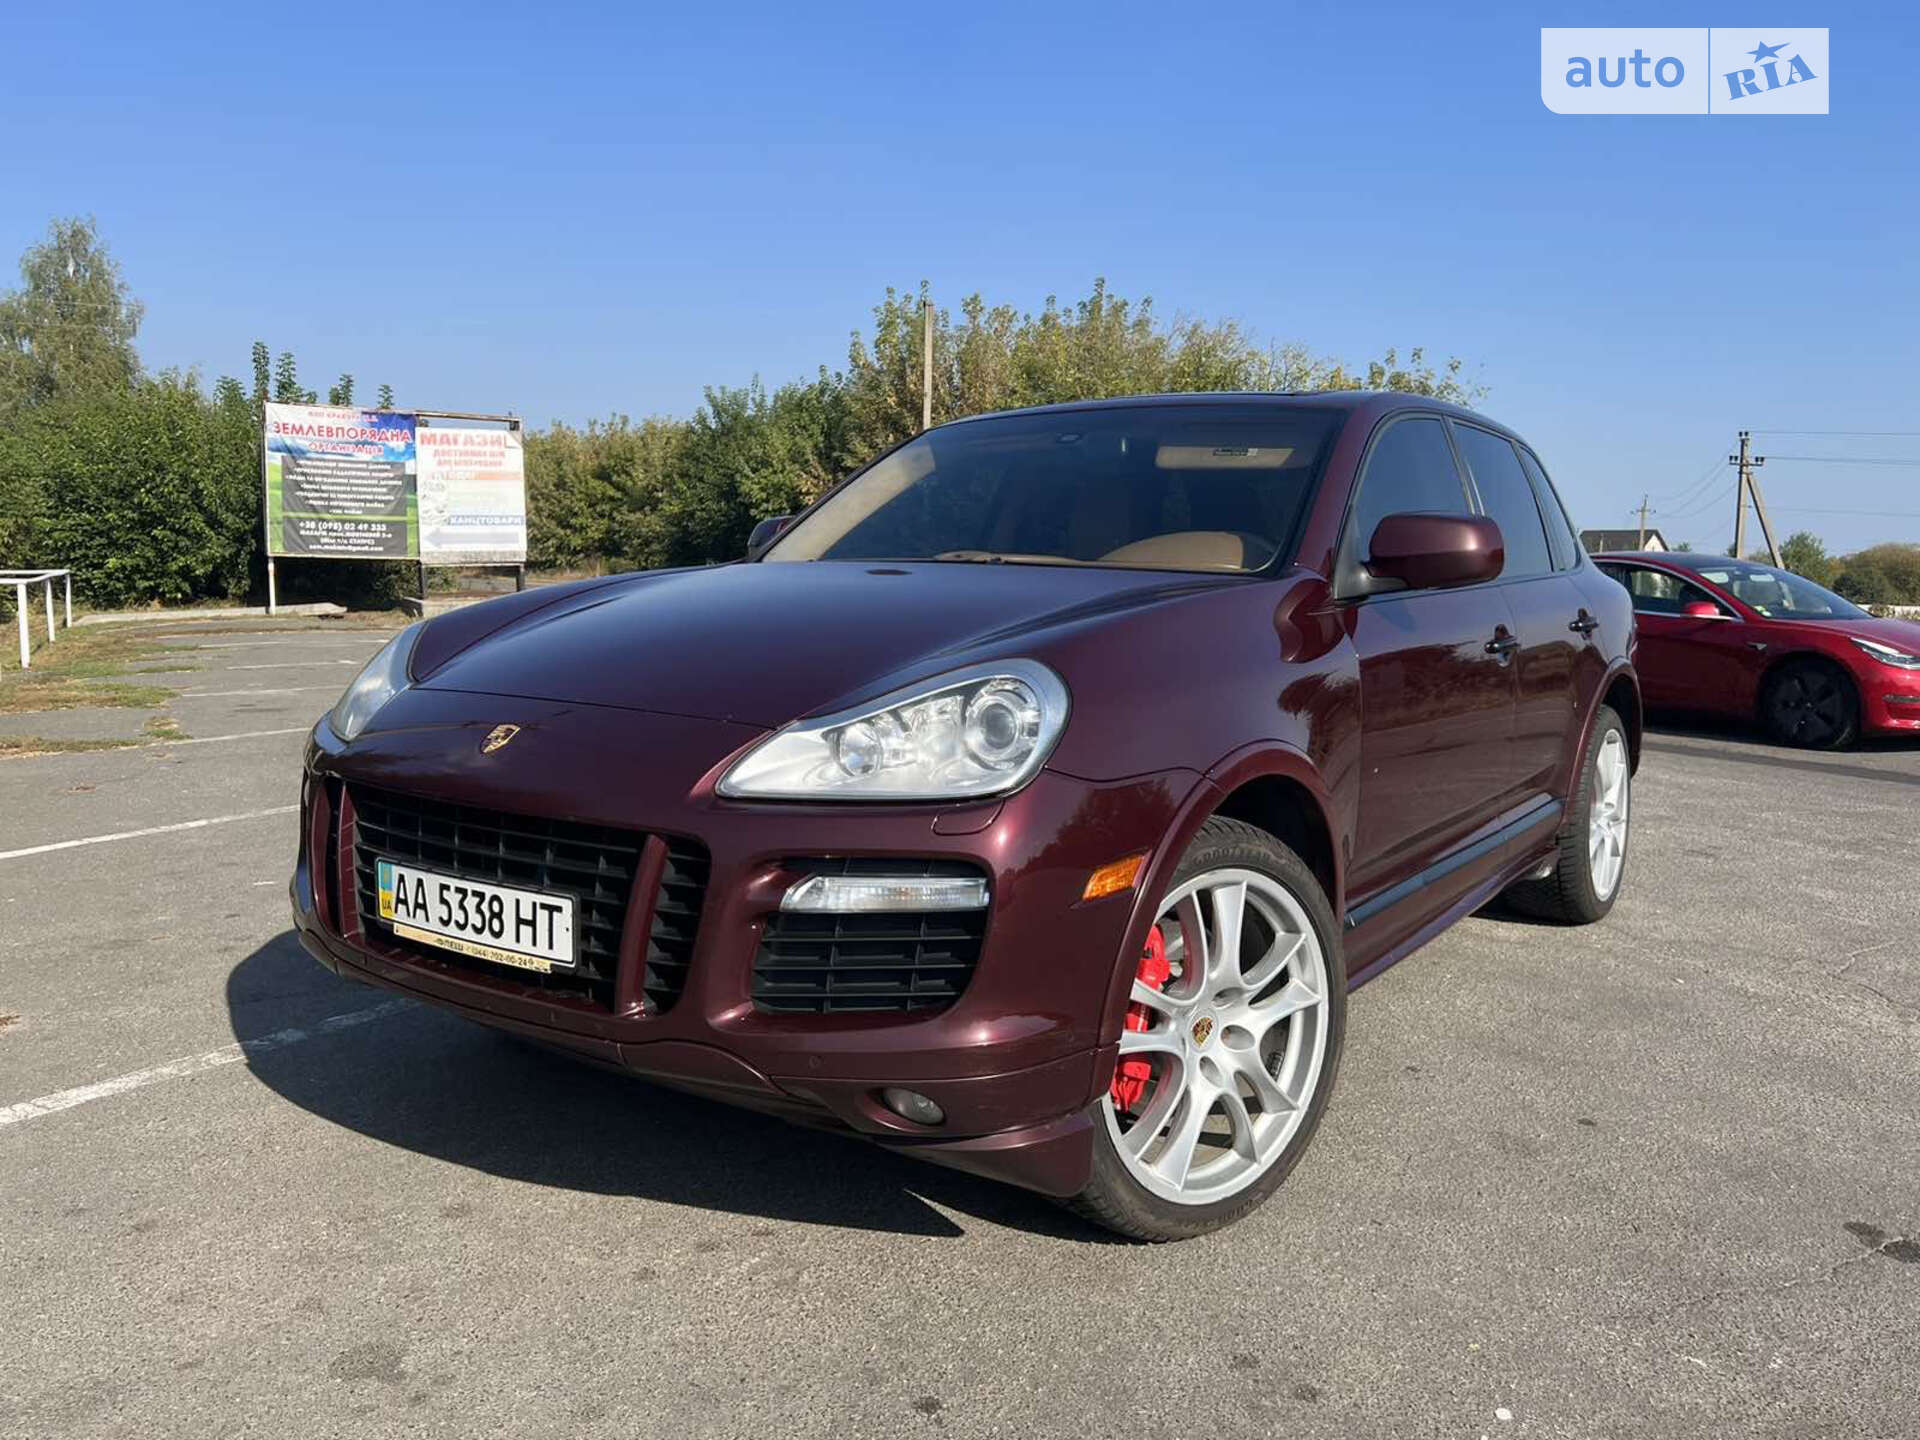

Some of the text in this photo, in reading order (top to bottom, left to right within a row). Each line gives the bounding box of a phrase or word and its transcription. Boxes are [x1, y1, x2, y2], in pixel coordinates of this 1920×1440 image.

[273, 421, 412, 442] ЗЕМЛЕВПОРЯДНА
[420, 431, 505, 448] МАГАЗИ
[394, 873, 563, 951] AA 5338 HT
